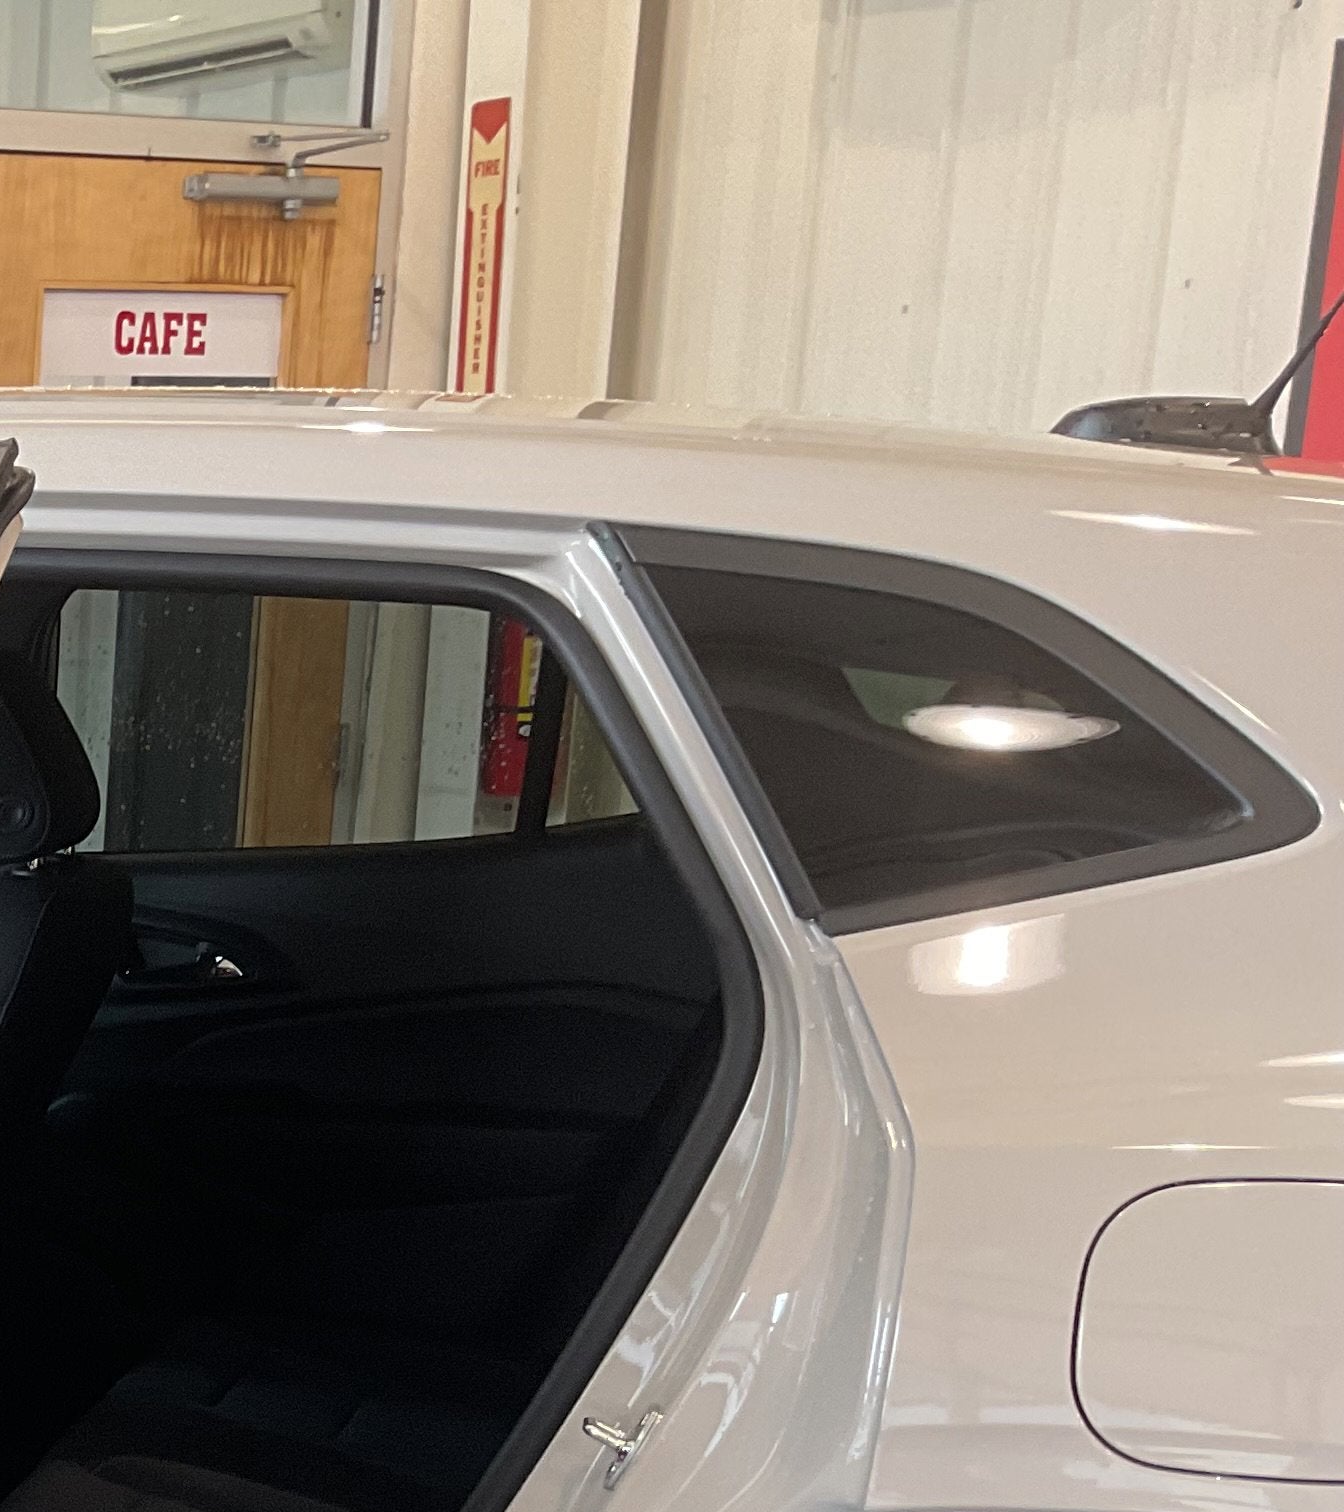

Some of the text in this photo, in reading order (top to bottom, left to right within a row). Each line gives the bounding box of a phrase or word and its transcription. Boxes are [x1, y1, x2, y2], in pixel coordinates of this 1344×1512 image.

[474, 159, 501, 178] FIRE
[472, 203, 489, 374] EXTINGUISHER
[114, 310, 208, 356] CAFE
